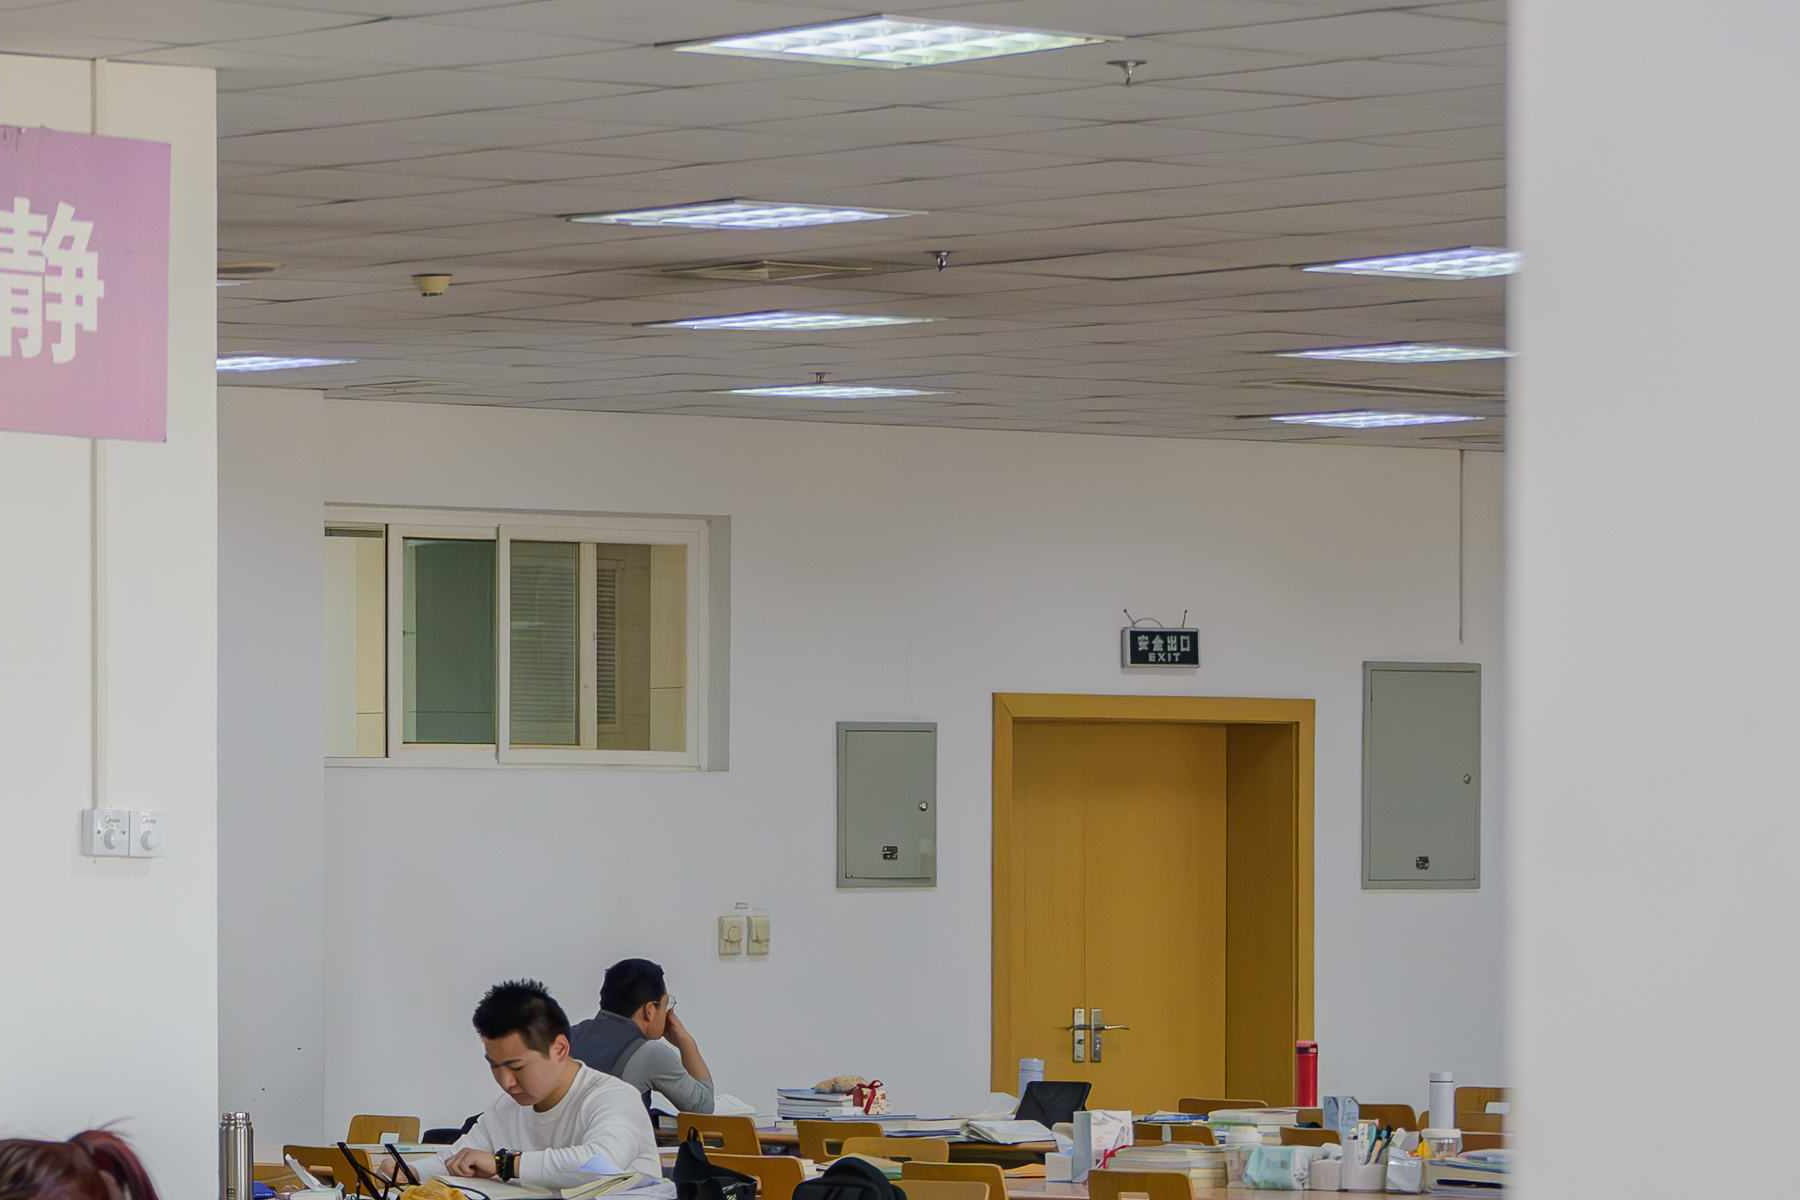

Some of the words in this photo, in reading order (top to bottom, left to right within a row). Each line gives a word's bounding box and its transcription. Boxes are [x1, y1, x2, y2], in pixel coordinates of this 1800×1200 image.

[1137, 634, 1191, 652] 安全出口
[1148, 652, 1181, 662] EXIT
